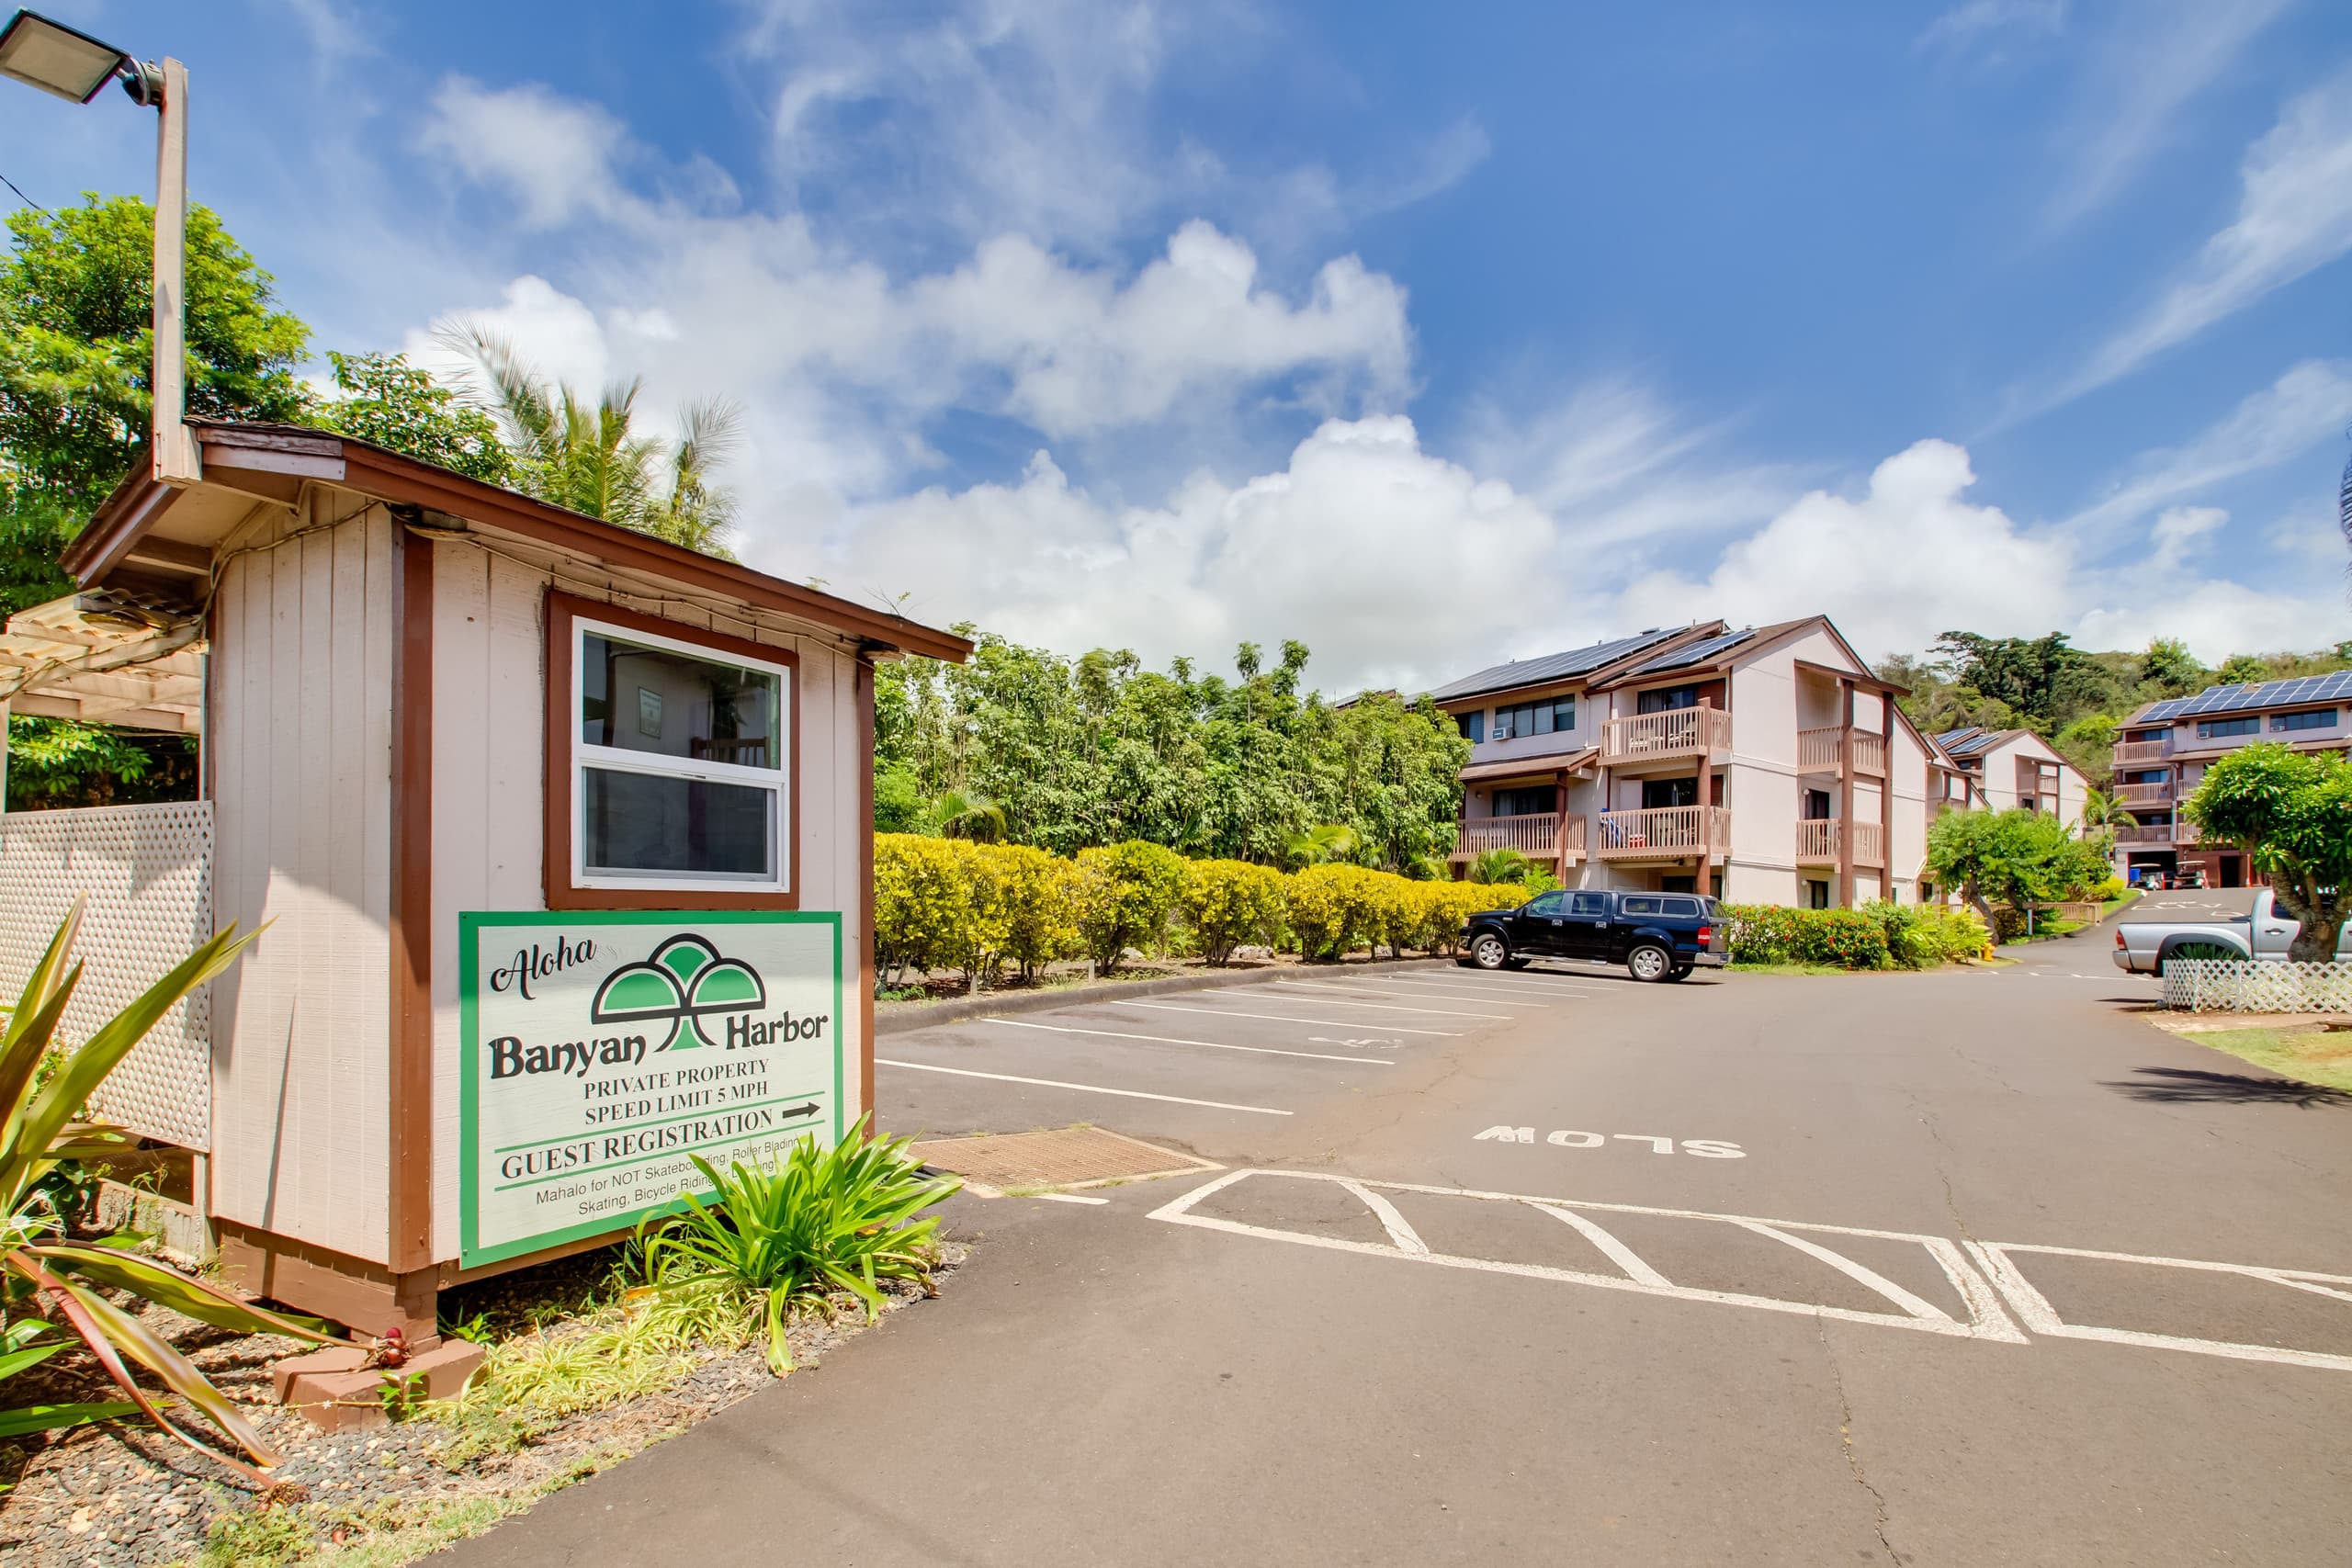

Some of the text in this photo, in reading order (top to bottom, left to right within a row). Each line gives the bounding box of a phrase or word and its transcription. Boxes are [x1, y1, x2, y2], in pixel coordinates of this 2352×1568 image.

[490, 935, 597, 1000] Aloha
[488, 1010, 829, 1079] Banyan Harbor
[584, 1058, 770, 1100] PRIVATE PROPERTY
[585, 1080, 768, 1124] SPEED LIMIT 5 MPH
[501, 1109, 774, 1179] GUEST REGISTRATION
[1473, 1125, 1747, 1158] SLOW
[537, 1185, 587, 1205] Mahalo
[591, 1178, 609, 1191] for
[612, 1169, 641, 1188] NOT
[645, 1154, 729, 1180] Skateboding,
[578, 1195, 630, 1215] Skating,
[634, 1182, 676, 1201] Bicycle
